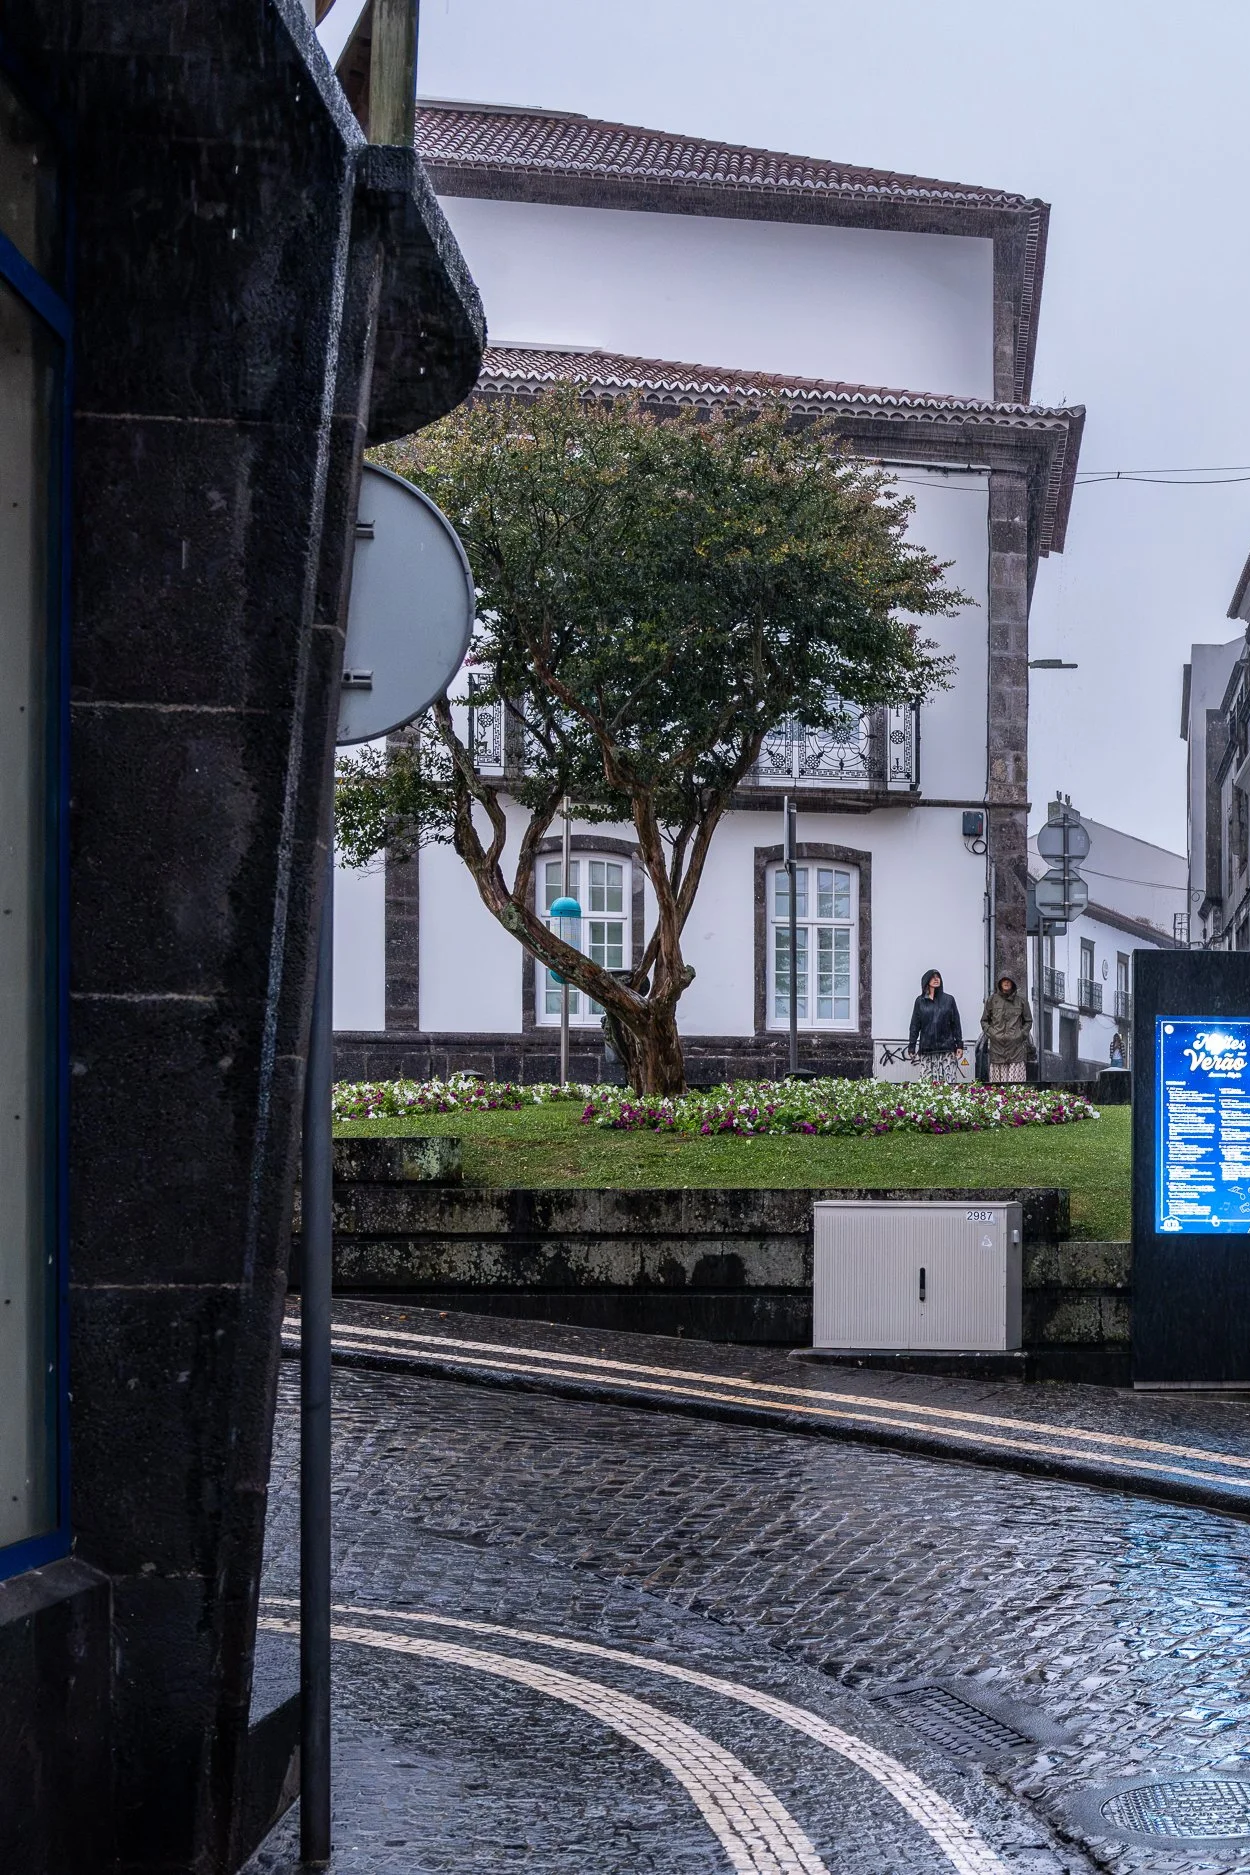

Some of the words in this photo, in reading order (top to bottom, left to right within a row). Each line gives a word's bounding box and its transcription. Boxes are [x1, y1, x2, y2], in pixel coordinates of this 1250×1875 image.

[1192, 1032, 1246, 1050] Nites
[1183, 1048, 1248, 1072] Verão
[967, 1211, 992, 1220] 2987
